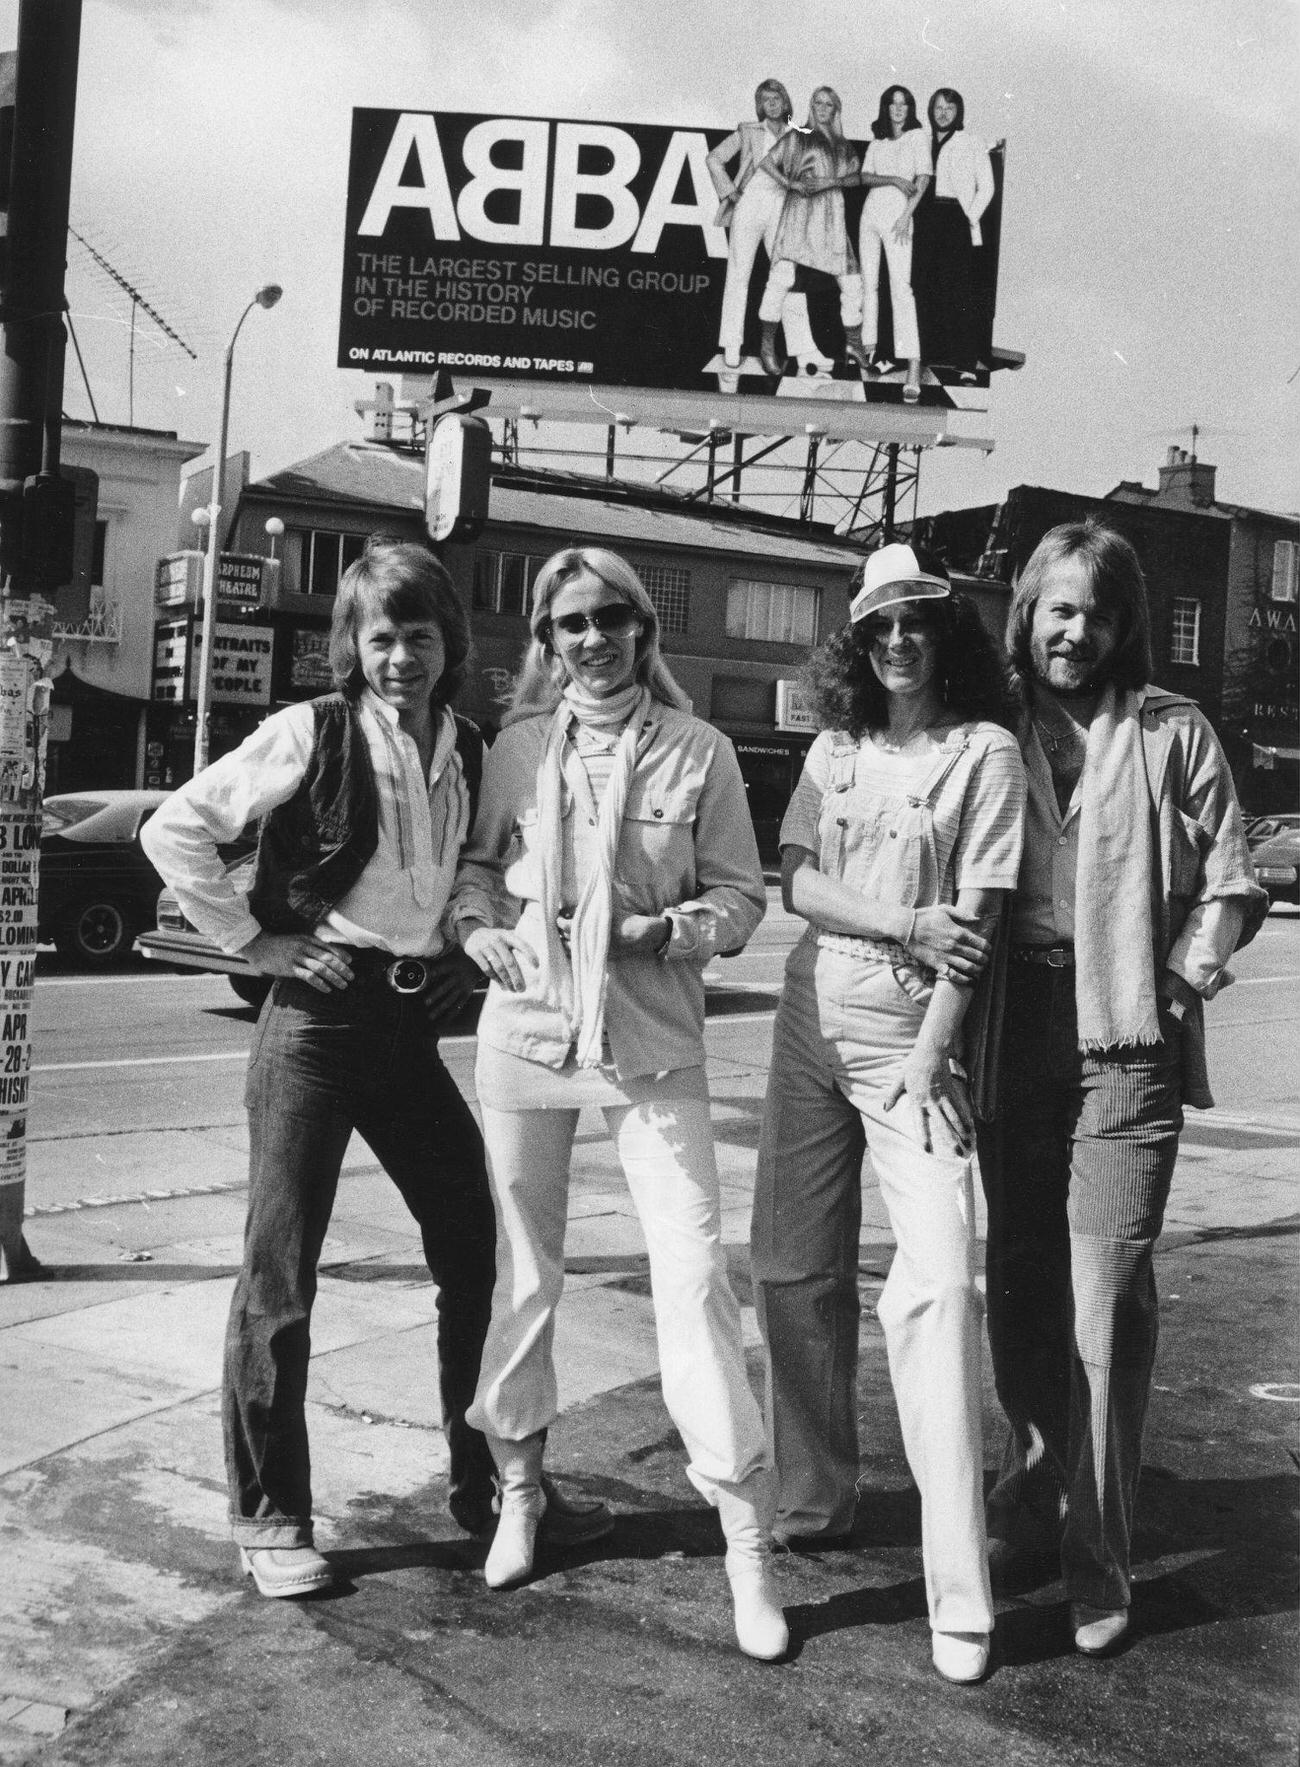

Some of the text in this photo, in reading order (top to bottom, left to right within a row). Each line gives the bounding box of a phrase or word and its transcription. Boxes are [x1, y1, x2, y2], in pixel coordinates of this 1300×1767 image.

[357, 113, 729, 259] ABBA
[357, 253, 711, 294] THE LARGEST SELLING GROUP
[355, 276, 534, 304] IN THE HISTORY
[353, 297, 597, 330] OF RECORDED MUSIC
[349, 347, 369, 361] ON
[372, 348, 435, 365] ATLANTIC
[437, 352, 501, 369] RECORDS
[503, 355, 532, 370] AND
[533, 357, 575, 373] TAPES
[217, 563, 261, 580] RPHEUM
[219, 579, 258, 597] HEATRE
[236, 658, 259, 673] MY
[212, 677, 262, 694] EOPLE
[737, 745, 790, 756] SANDWICHES
[2, 1014, 27, 1041] APR
